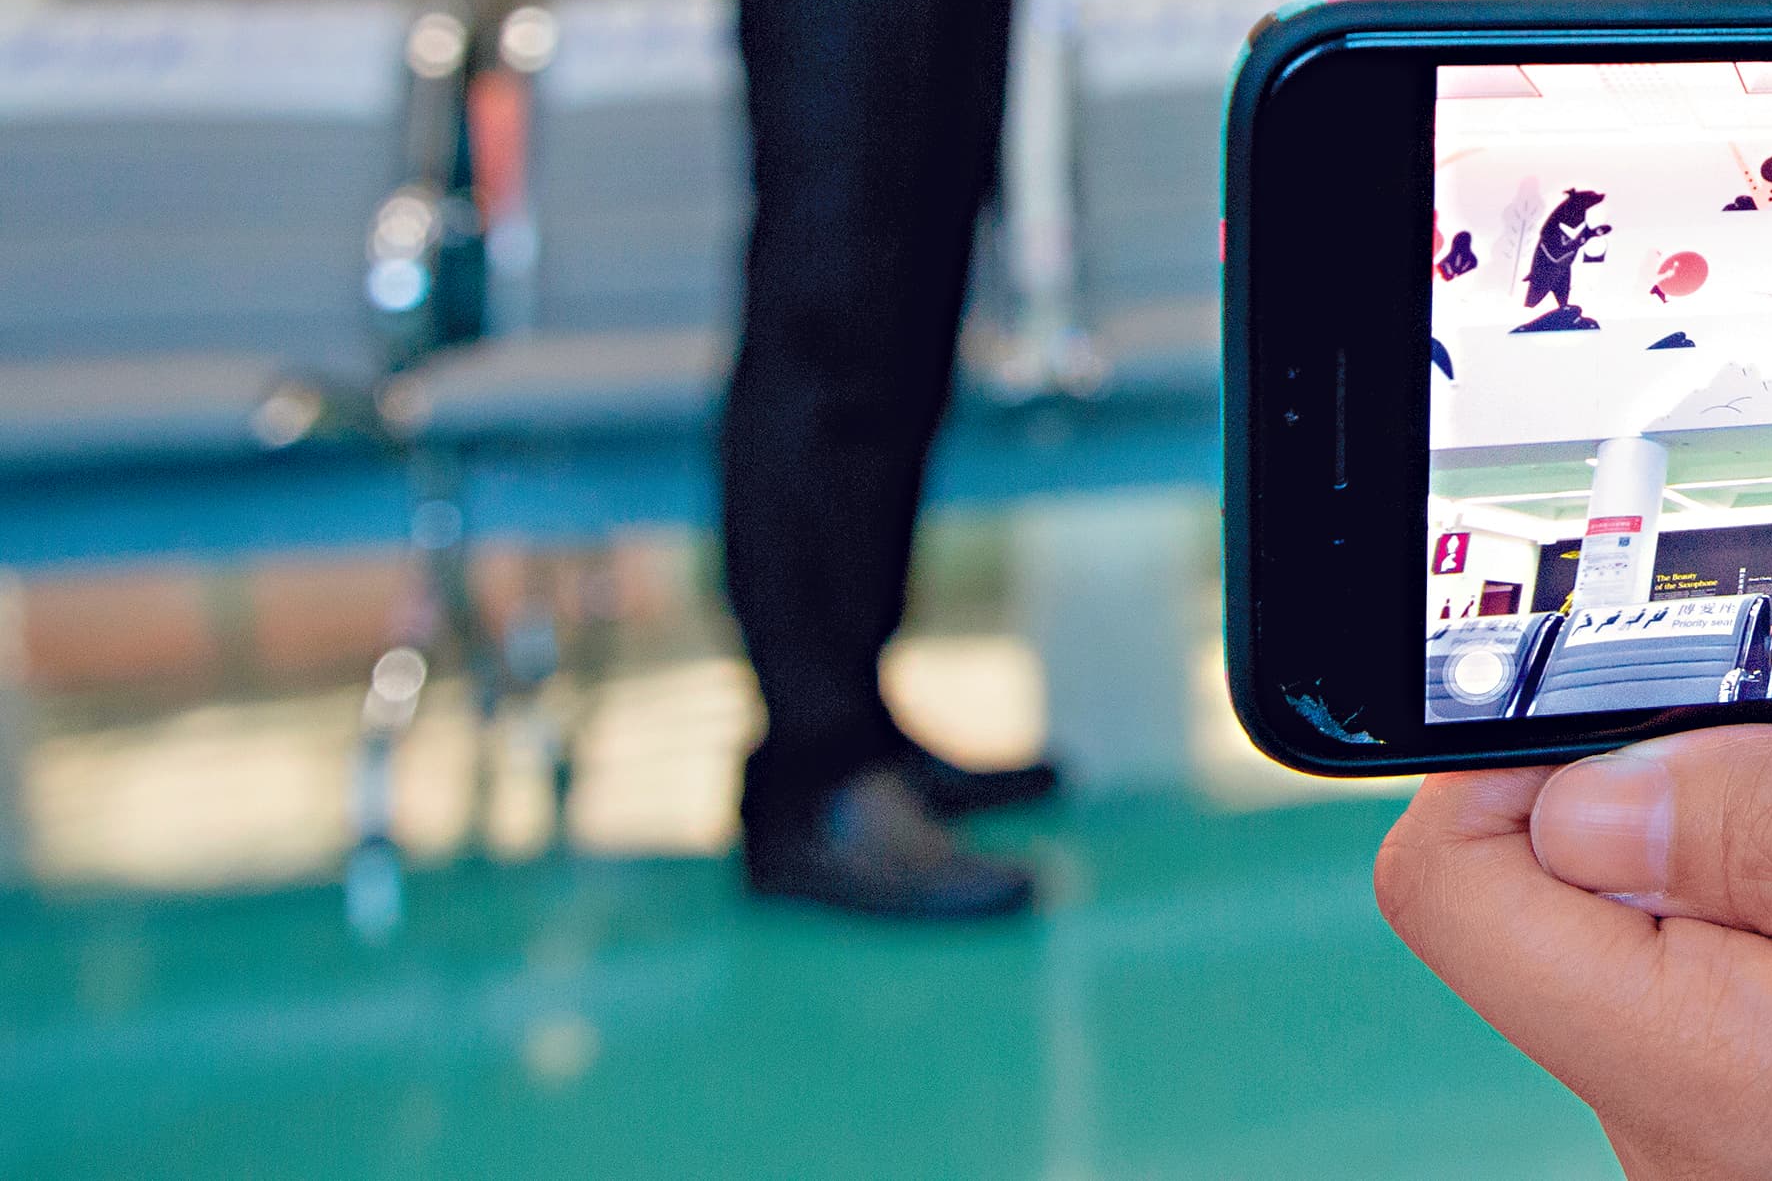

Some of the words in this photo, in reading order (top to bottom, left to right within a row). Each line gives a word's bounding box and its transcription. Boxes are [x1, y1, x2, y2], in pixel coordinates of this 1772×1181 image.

[1656, 574, 1670, 582] The
[1672, 573, 1697, 581] Beauty
[1664, 582, 1677, 590] the
[1677, 580, 1719, 589] Saxophone
[1672, 619, 1707, 628] Priority
[1711, 619, 1734, 627] seat
